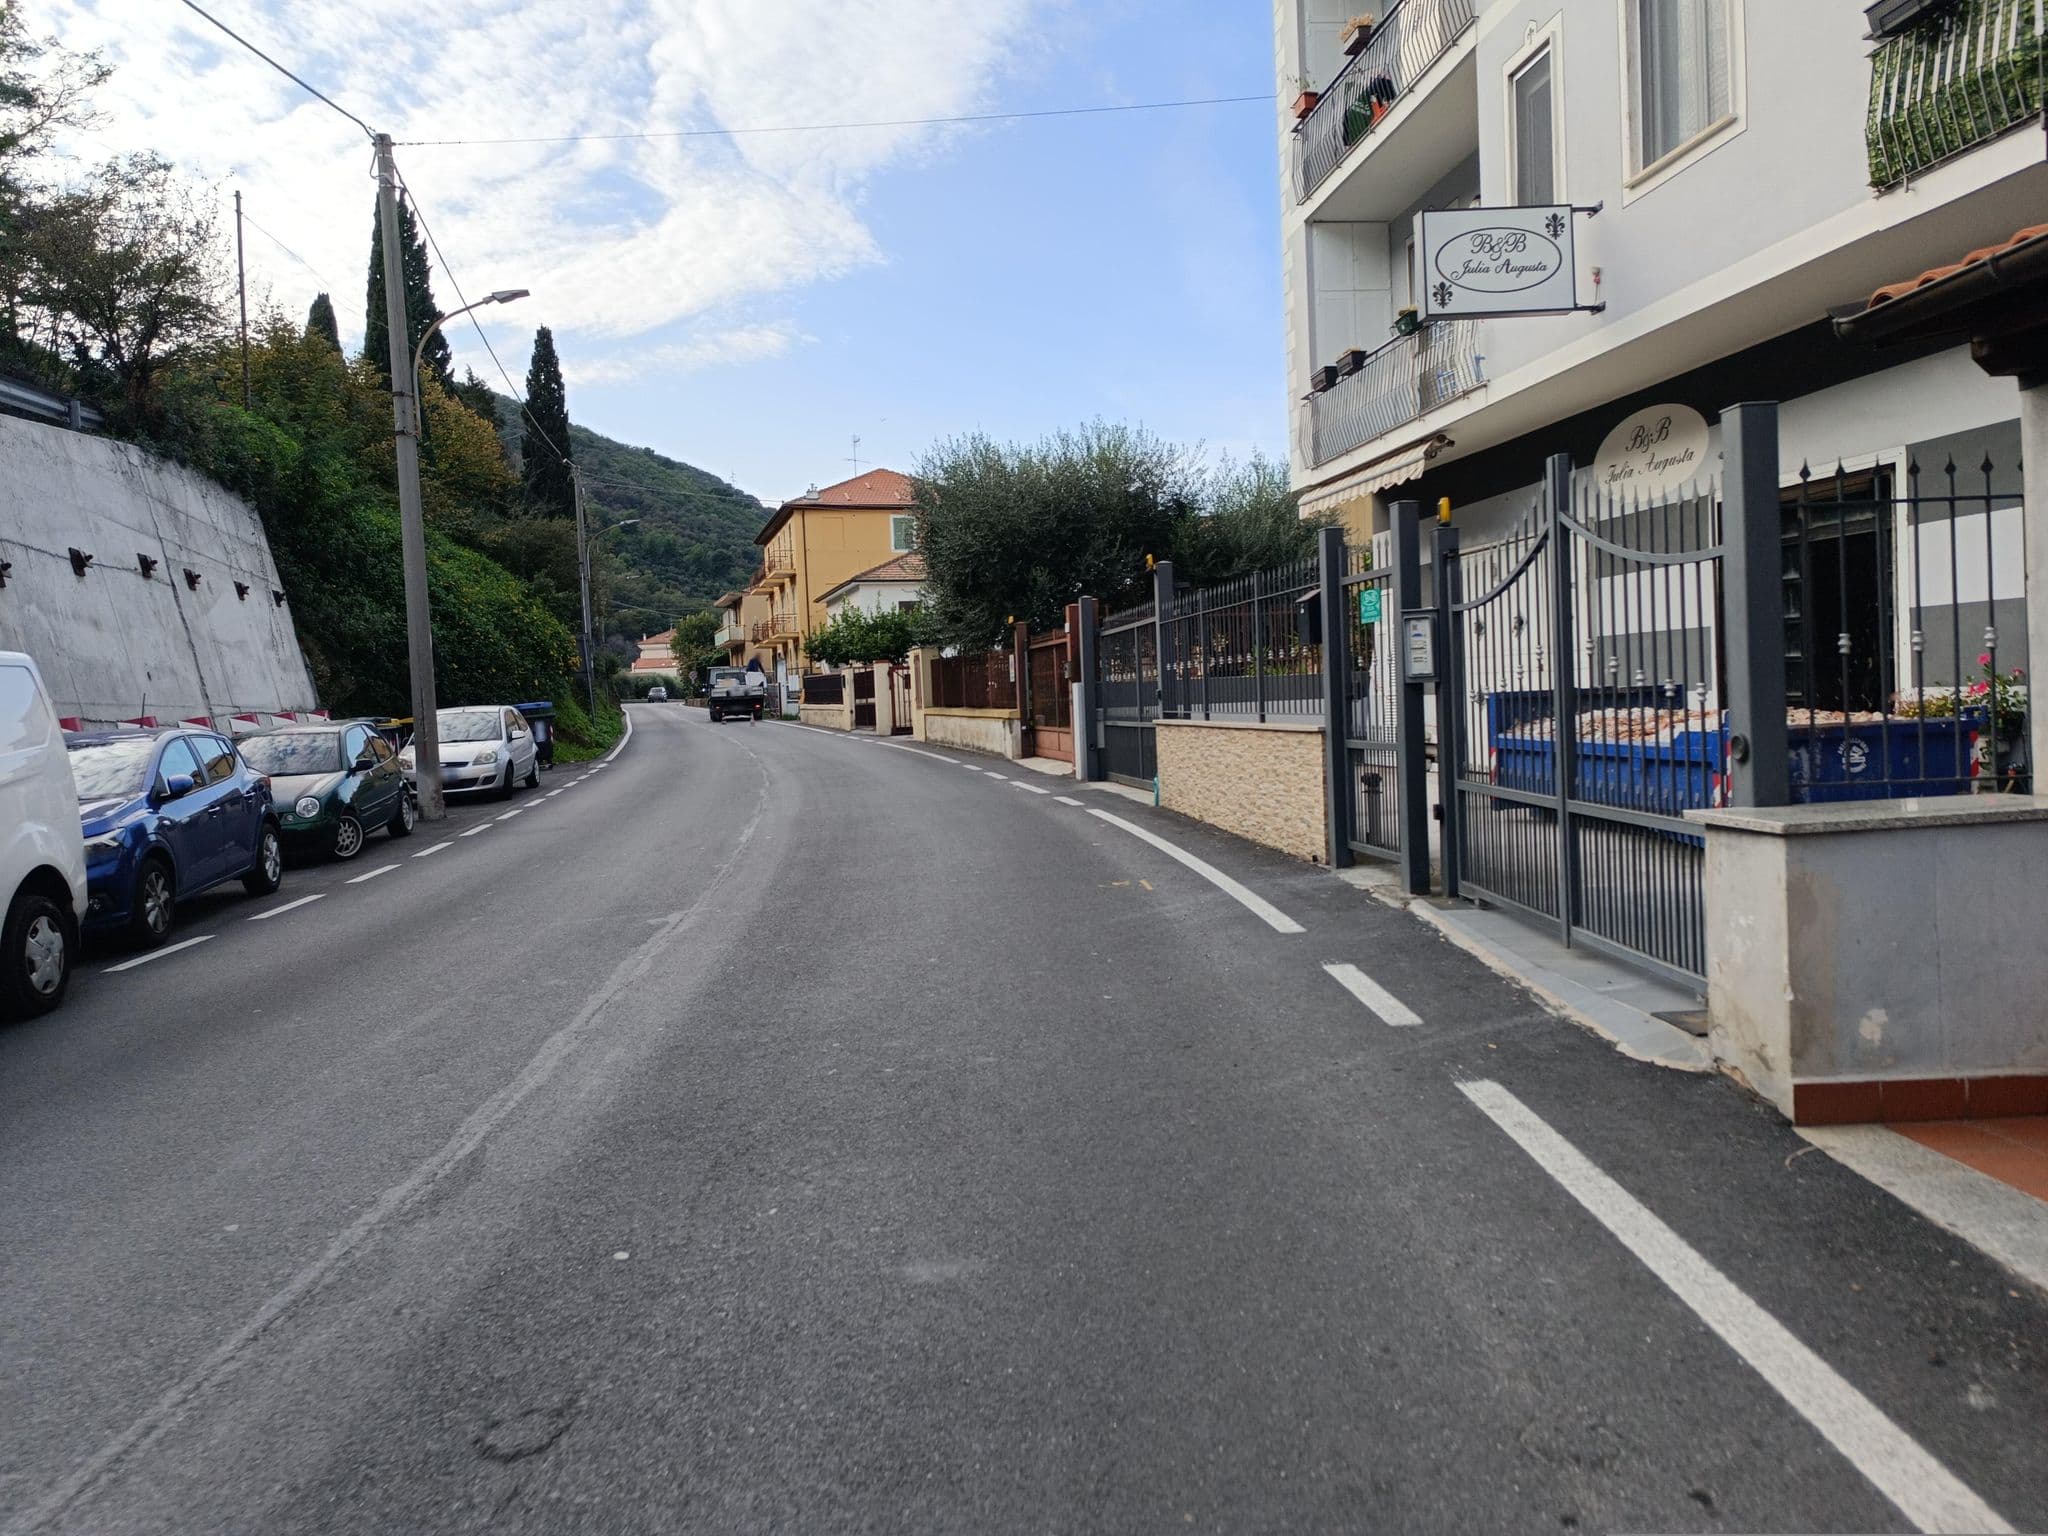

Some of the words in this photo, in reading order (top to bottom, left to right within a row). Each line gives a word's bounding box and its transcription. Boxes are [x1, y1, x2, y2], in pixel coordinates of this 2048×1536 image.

[1470, 232, 1527, 261] B&B
[1450, 259, 1491, 281] Julia
[1494, 258, 1547, 279] Augusta
[1625, 416, 1672, 453] B&B
[1605, 461, 1634, 484] Julia
[1638, 447, 1695, 476] Augusta
